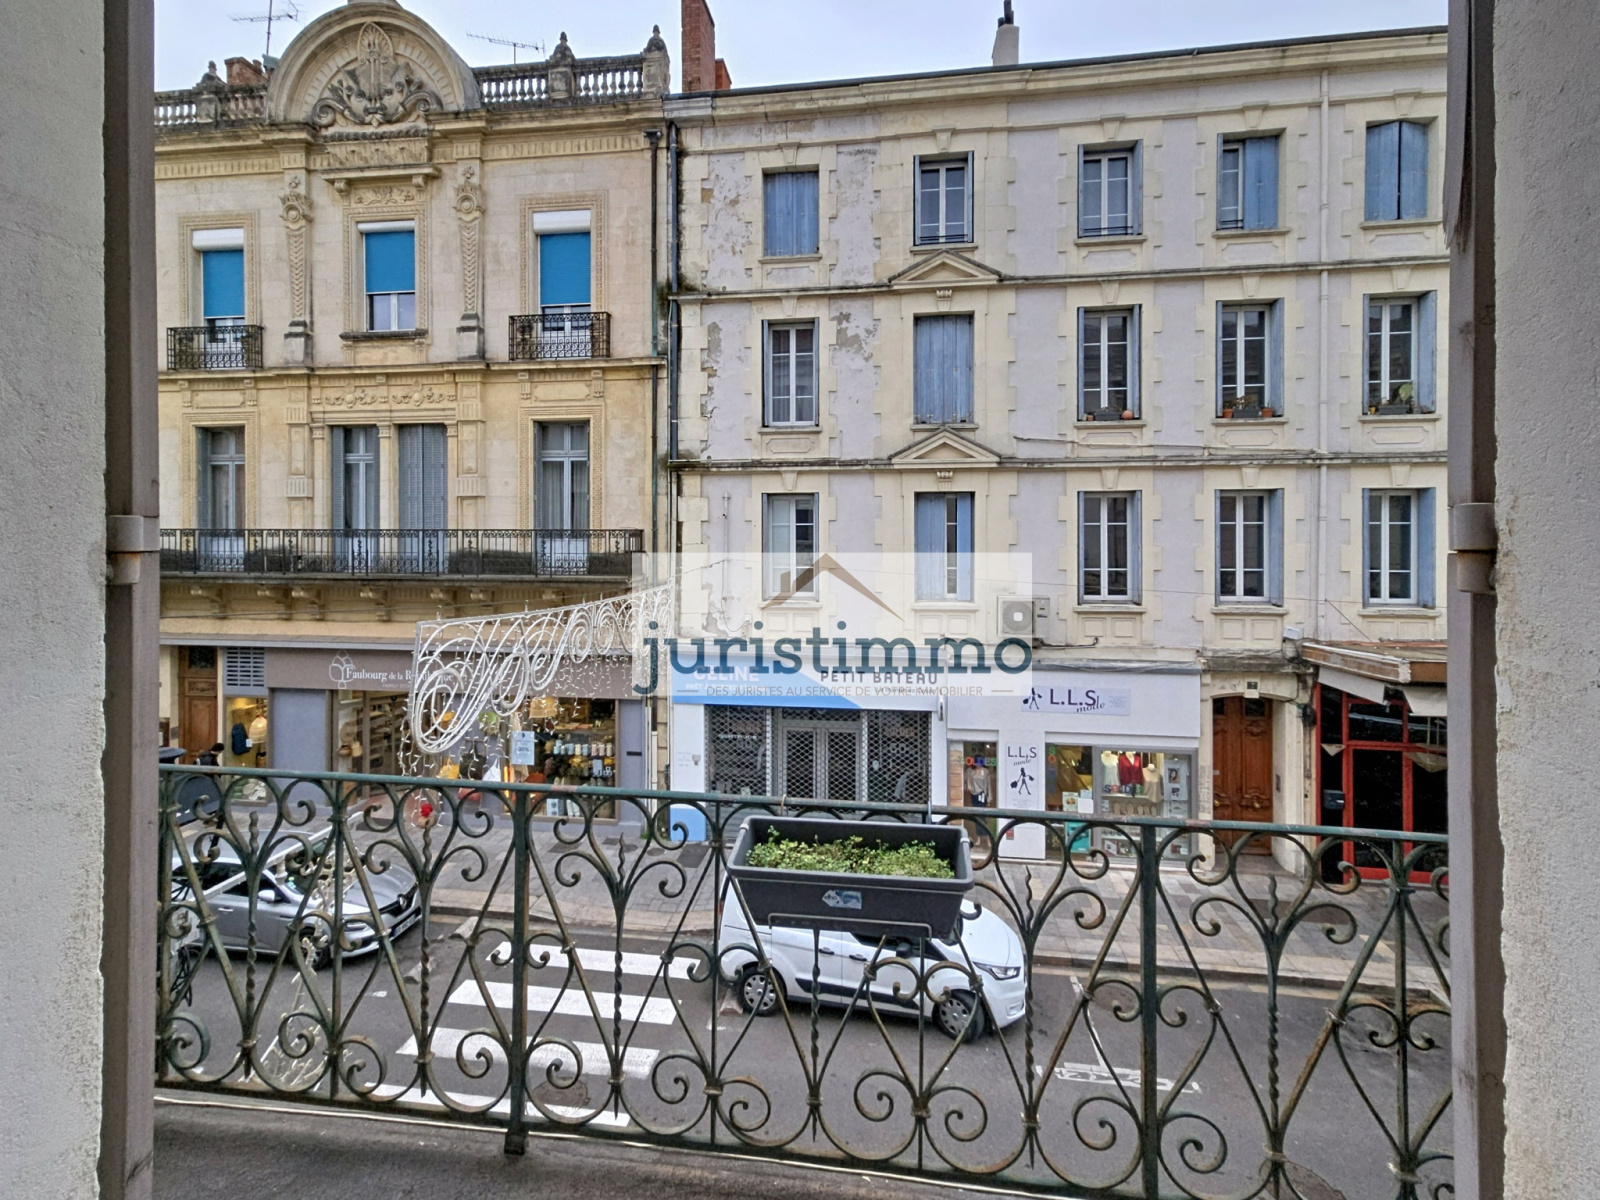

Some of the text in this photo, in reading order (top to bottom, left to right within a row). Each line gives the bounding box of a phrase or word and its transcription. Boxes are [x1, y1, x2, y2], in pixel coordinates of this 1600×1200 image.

[346, 667, 388, 683] Faubourg
[389, 672, 397, 680] de
[397, 672, 404, 680] la
[820, 670, 938, 685] PETIT BATEAU
[1049, 688, 1097, 706] L.L.S
[1076, 695, 1106, 713] mode
